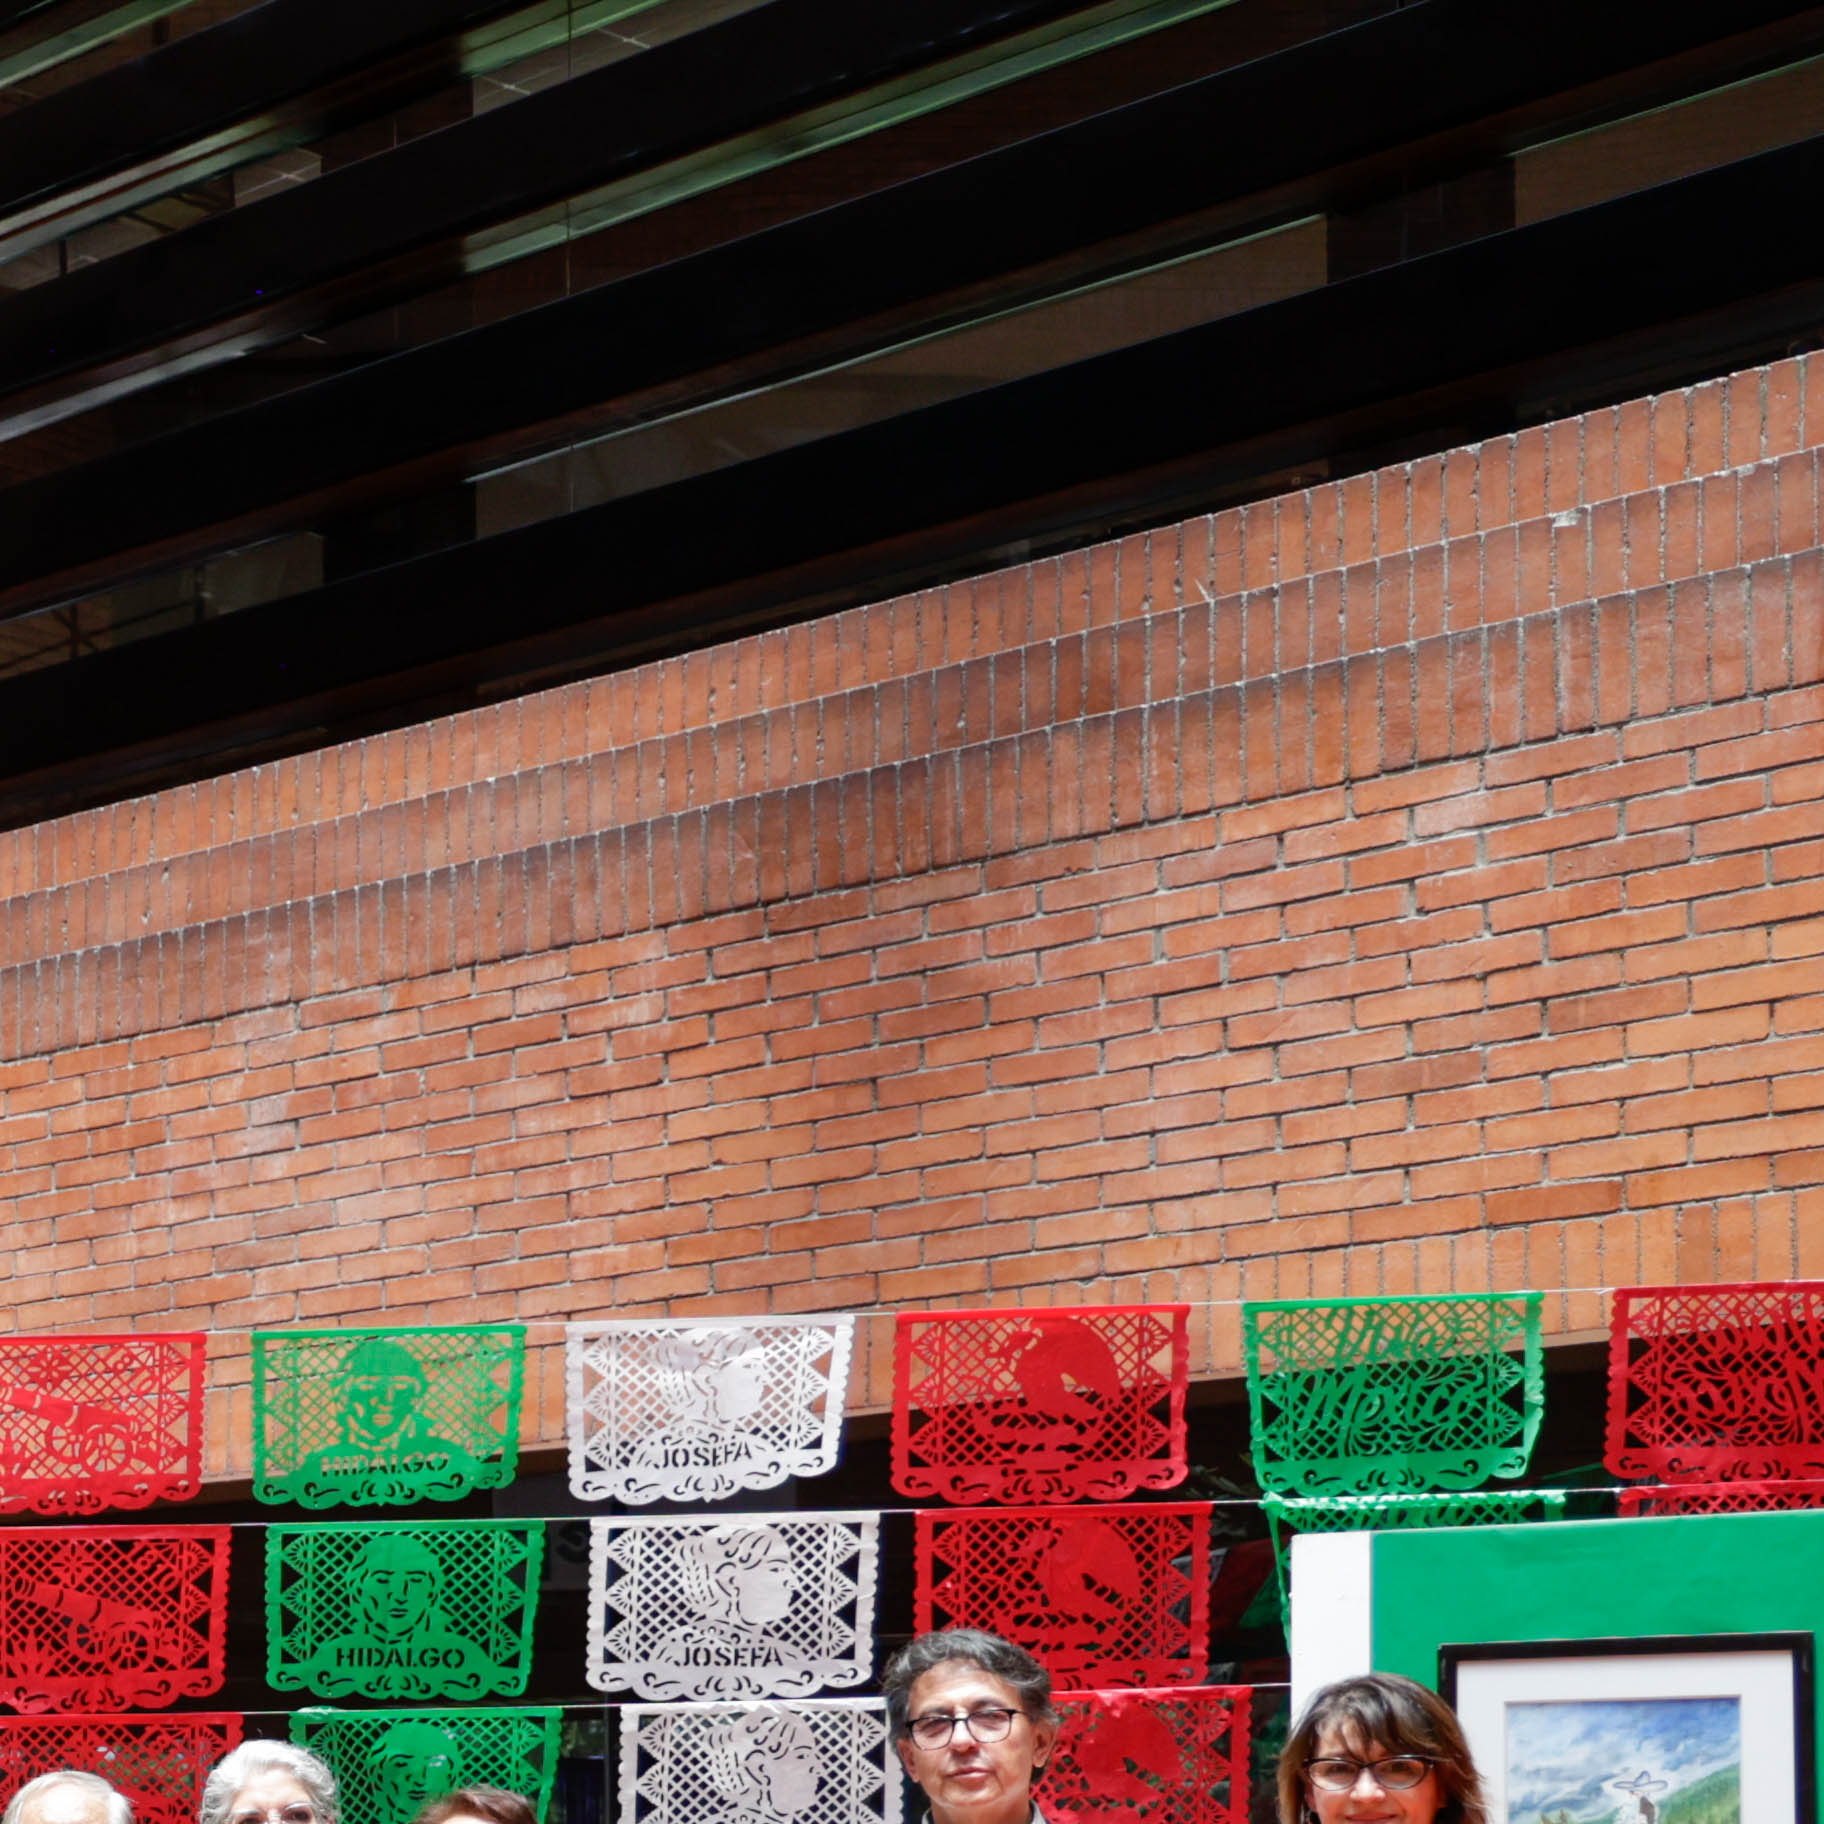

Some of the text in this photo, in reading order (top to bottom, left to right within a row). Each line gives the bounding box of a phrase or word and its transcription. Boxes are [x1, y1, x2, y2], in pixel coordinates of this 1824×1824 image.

[321, 1452, 449, 1478] HIDALGO
[655, 1443, 753, 1471] JOSEFA
[335, 1646, 465, 1670] HIDALGO
[674, 1646, 785, 1669] JOSEFA
